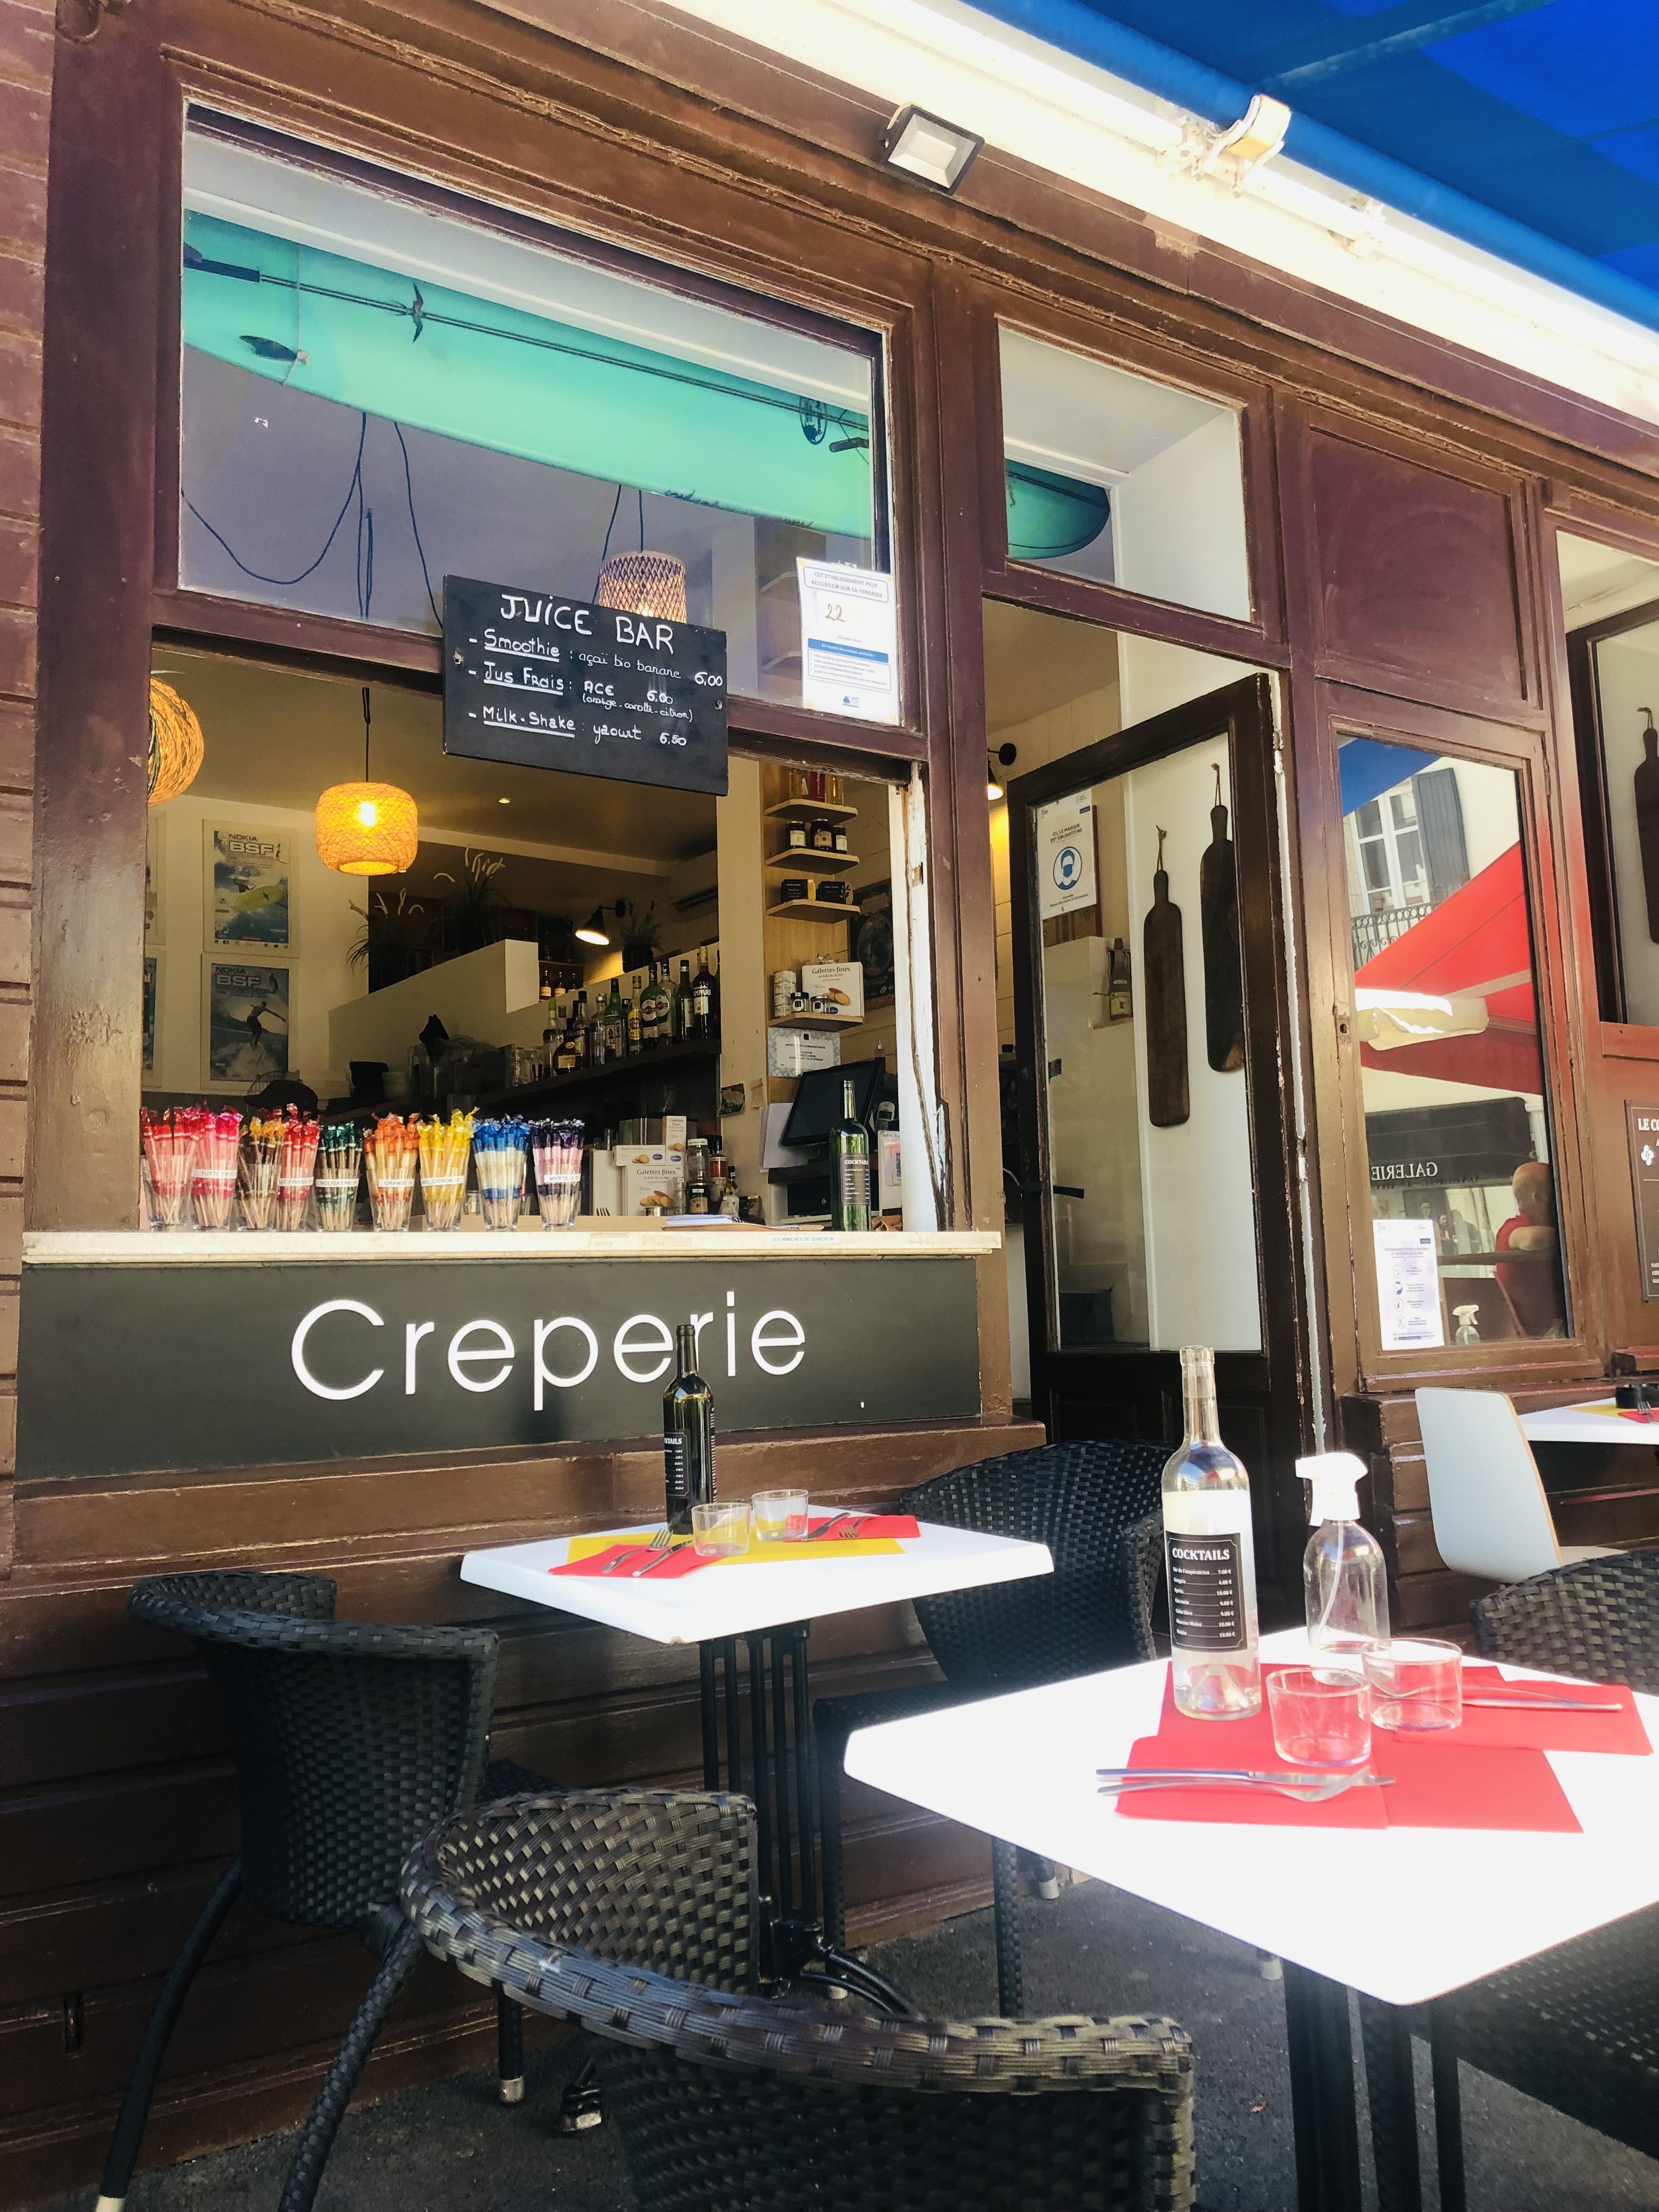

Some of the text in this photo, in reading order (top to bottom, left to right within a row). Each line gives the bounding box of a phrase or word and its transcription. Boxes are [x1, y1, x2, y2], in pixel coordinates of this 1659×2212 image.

[811, 580, 839, 589] ACCUEILLIR
[859, 589, 883, 599] TERRASSE
[825, 574, 865, 586] ETABLISSEMENT
[825, 603, 846, 623] 22
[615, 616, 674, 654] BAR
[484, 628, 560, 657] Smoothie
[614, 654, 631, 668] bio
[637, 660, 681, 679] banane
[695, 672, 723, 686] 6,00
[484, 661, 514, 684] Jus
[584, 680, 614, 696] ACE
[593, 724, 642, 744] yaourt
[229, 840, 274, 855] BSF
[216, 974, 261, 988] BSF
[1637, 1118, 1650, 1131] LE
[292, 1291, 805, 1412] Creperie
[1172, 1548, 1231, 1561] COCKTAILS
